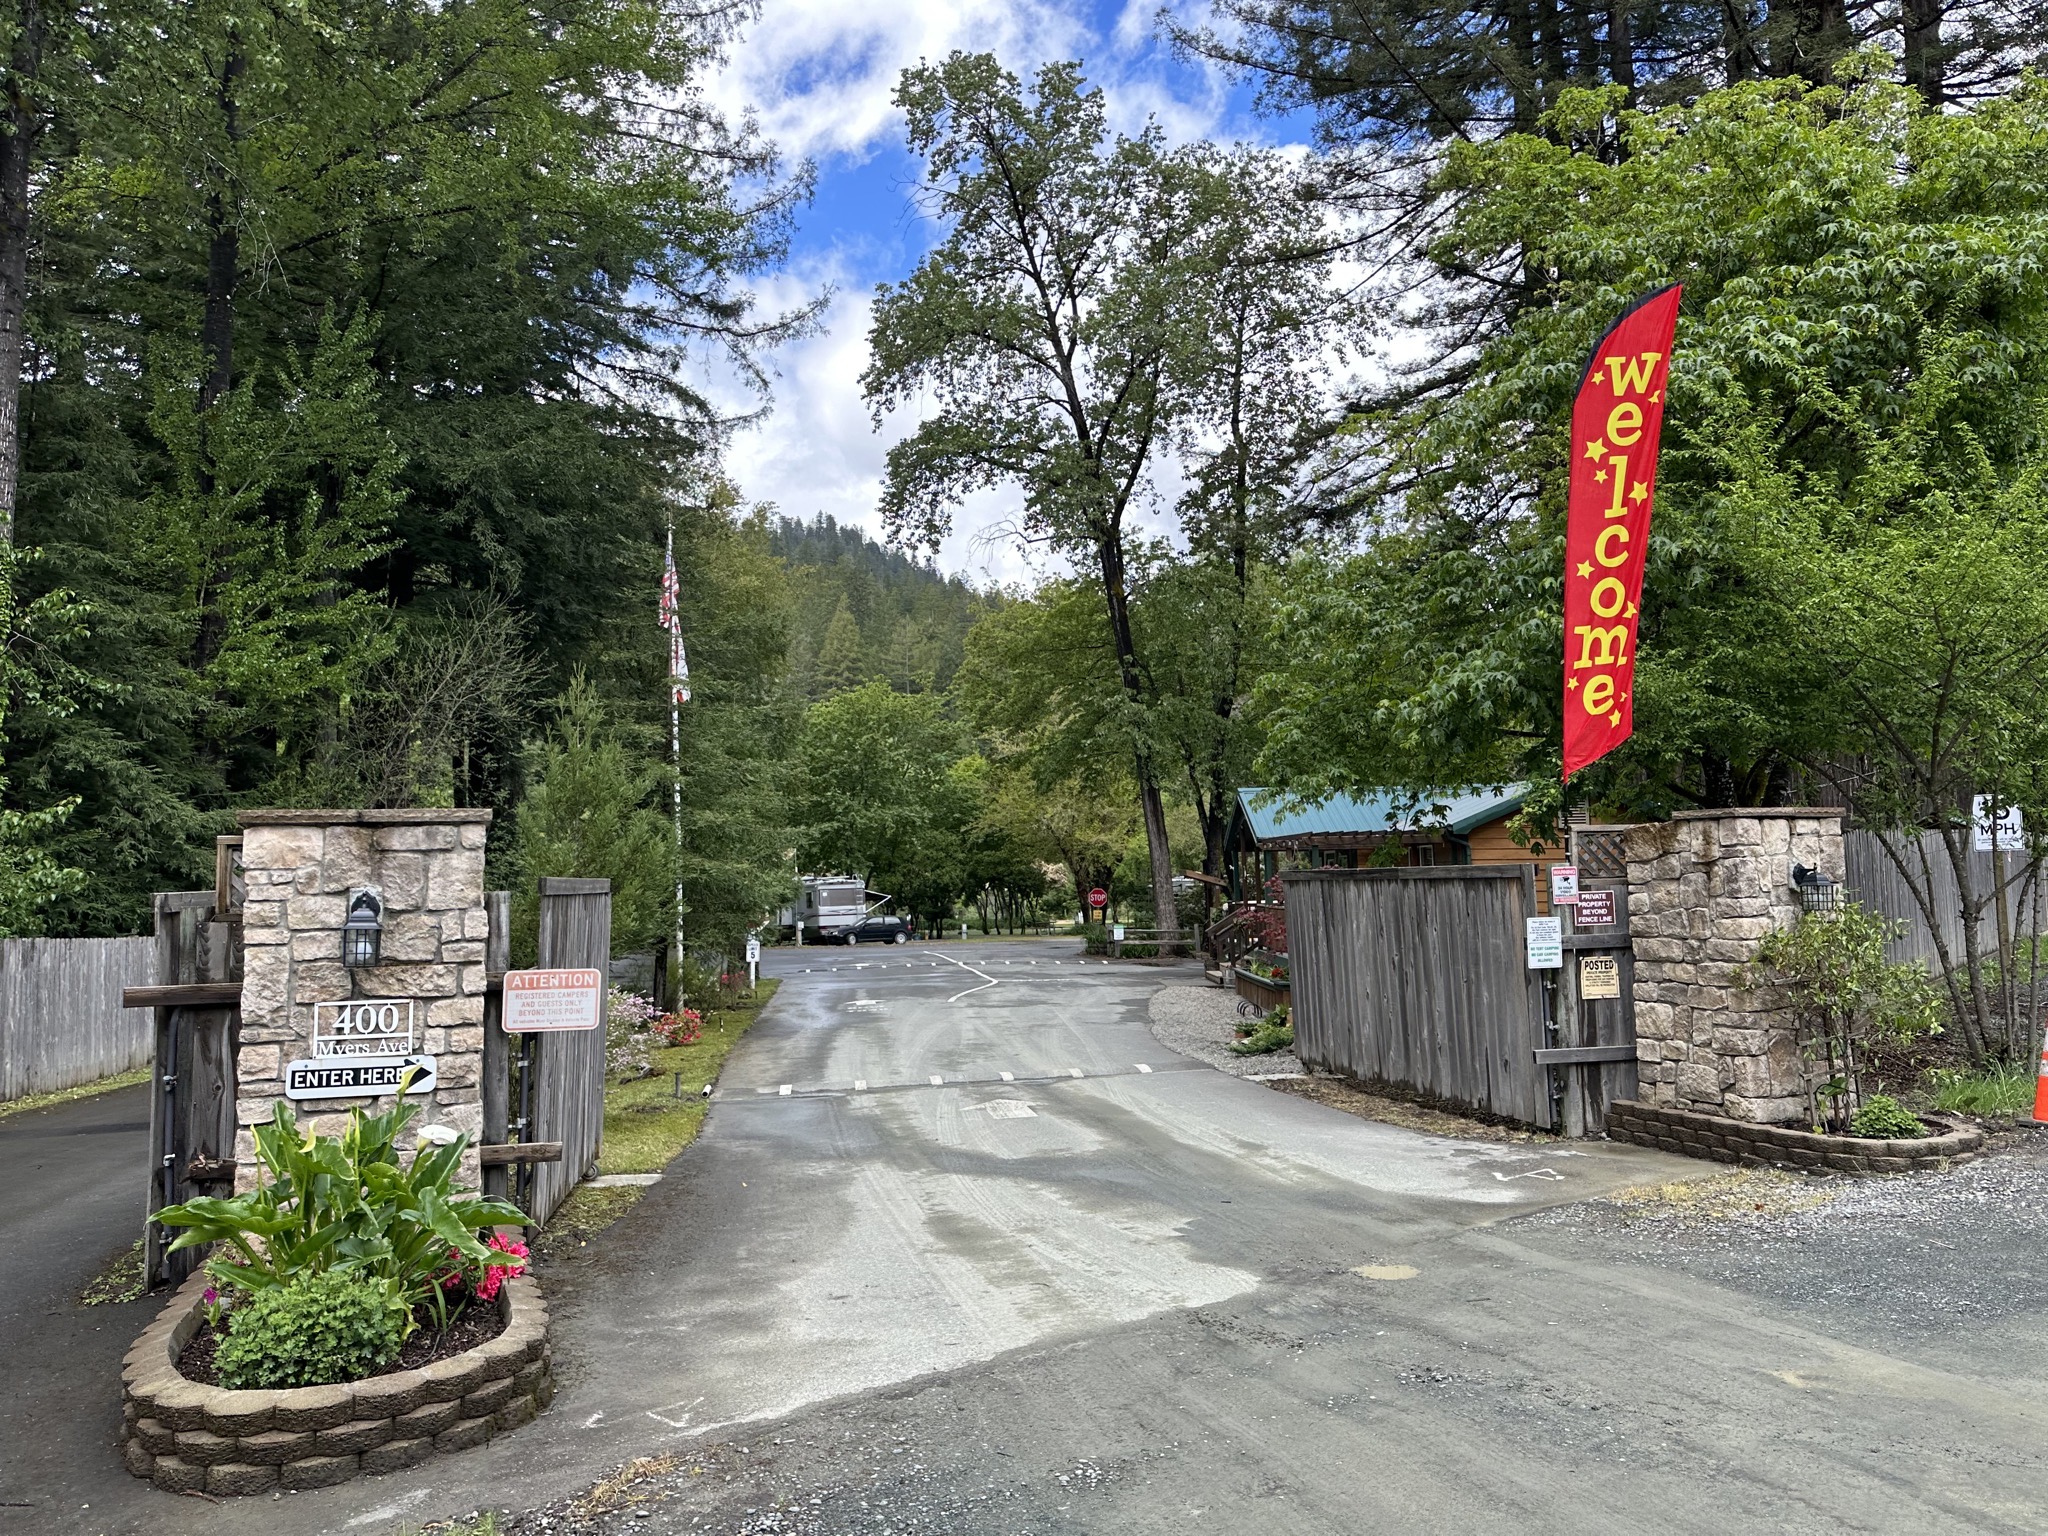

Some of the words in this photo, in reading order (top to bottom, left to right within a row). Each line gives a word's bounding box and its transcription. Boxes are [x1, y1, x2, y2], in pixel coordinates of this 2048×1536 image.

[1573, 352, 1662, 716] welcome
[1980, 823, 2015, 836] MPH
[1584, 960, 1614, 971] POSTED
[512, 973, 594, 988] ATTENTION
[515, 991, 555, 1000] REGISTERED
[557, 991, 589, 999] CAMPERS
[332, 1004, 399, 1035] 400
[518, 1009, 545, 1017] BEYOND
[564, 1007, 584, 1015] POINT
[318, 1041, 370, 1056] Myers
[377, 1038, 408, 1054] Ave
[294, 1069, 354, 1088] ENTER
